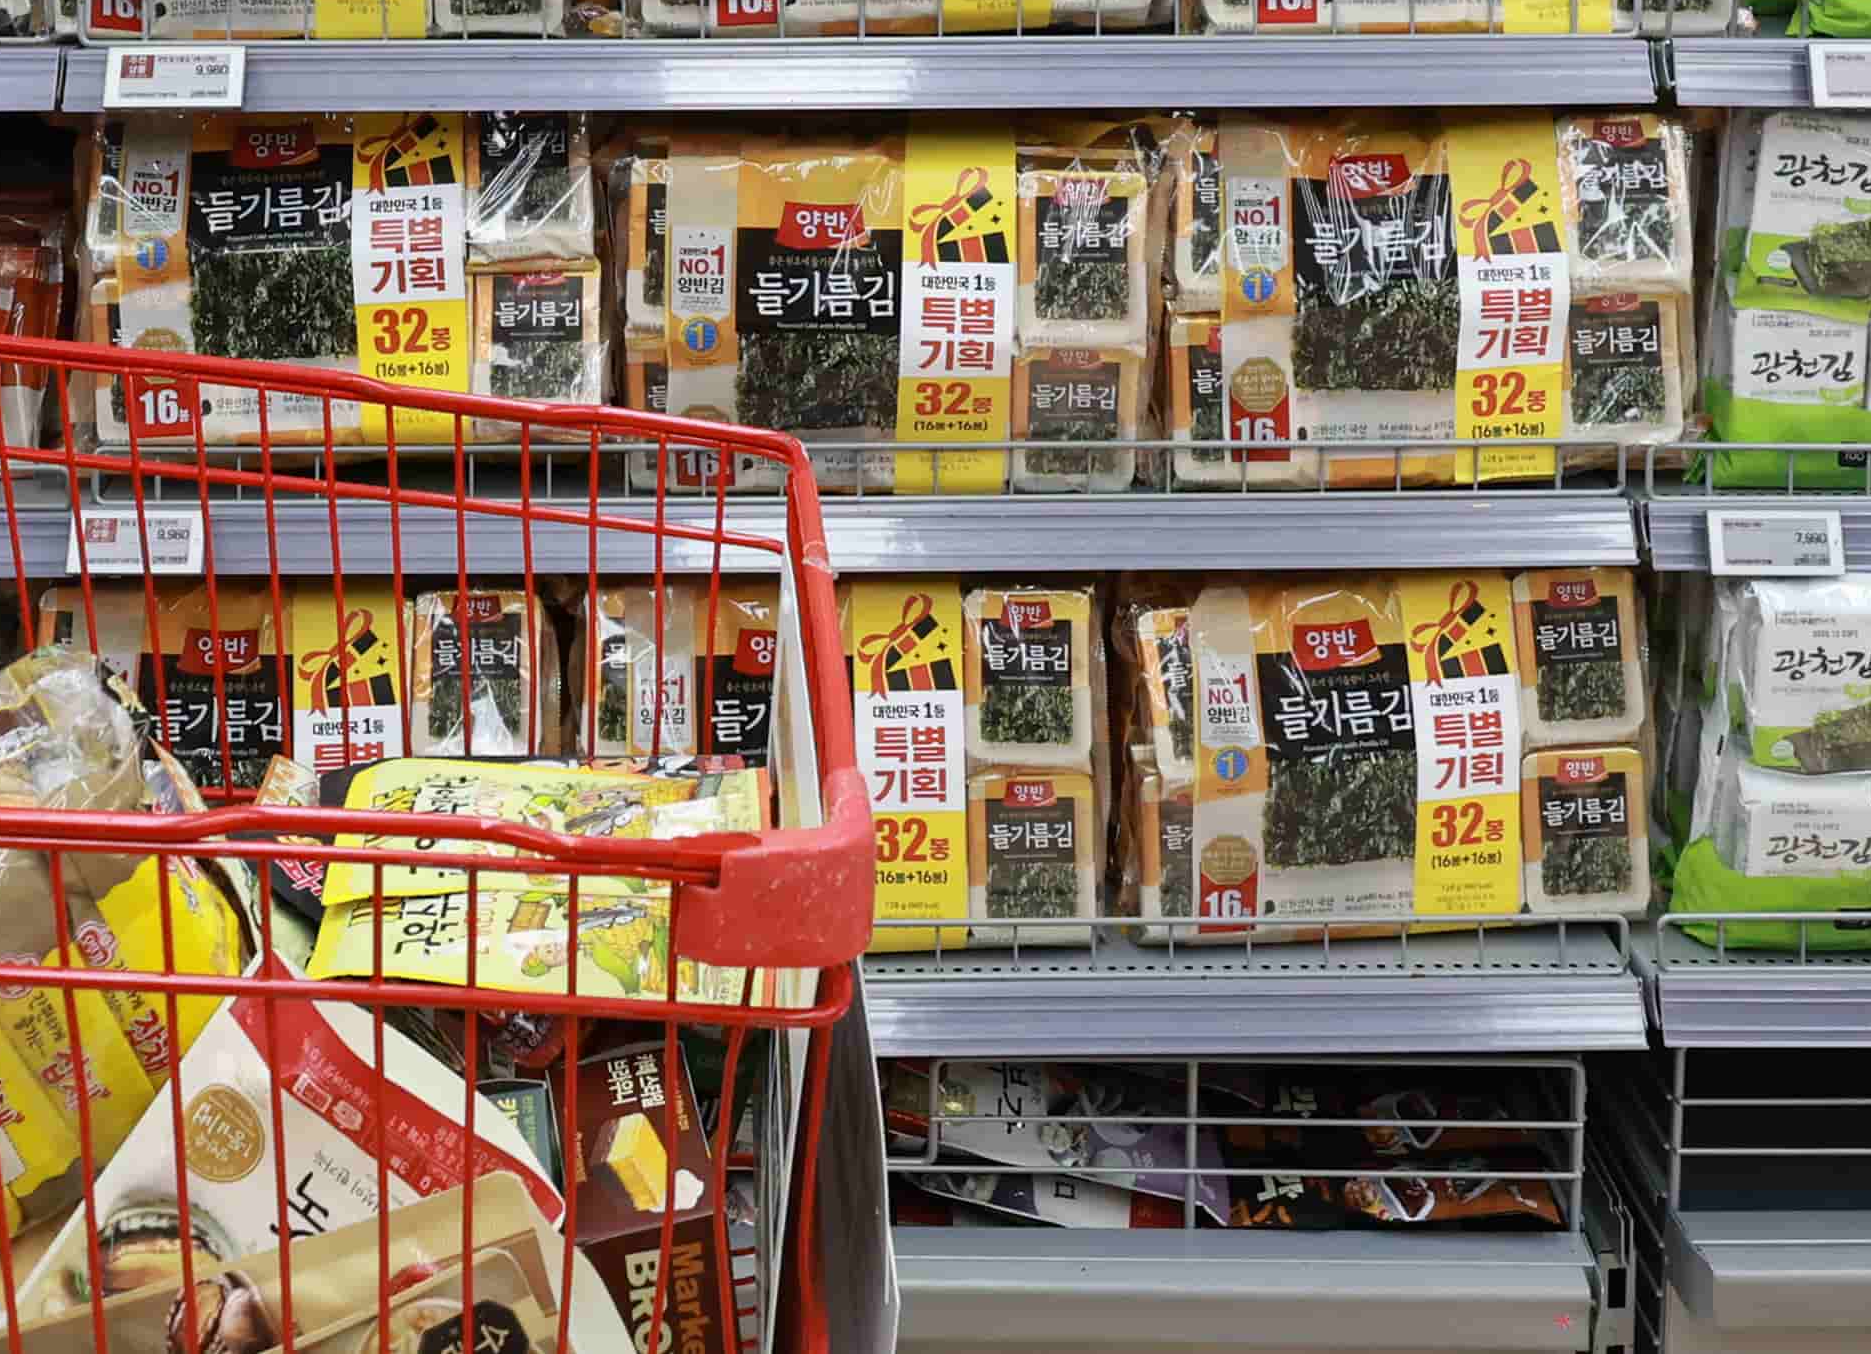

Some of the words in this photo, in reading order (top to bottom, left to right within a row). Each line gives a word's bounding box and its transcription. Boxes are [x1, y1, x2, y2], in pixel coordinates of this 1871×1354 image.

[132, 175, 179, 198] NO.1
[200, 186, 344, 232] 들기름김
[369, 198, 417, 213] 대한민국
[421, 195, 442, 212] 1등
[370, 216, 443, 255] 특별
[371, 259, 447, 294] 기획
[679, 277, 724, 295] 양반김
[1477, 267, 1526, 282] 대한민국
[1529, 265, 1551, 281] 1등
[921, 297, 995, 334] 특별
[1480, 288, 1552, 322] 특별
[920, 340, 994, 371] 기획
[1476, 328, 1548, 359] 기획
[1576, 327, 1659, 355] 들기름김
[1304, 628, 1356, 660] 양반
[873, 704, 920, 719] 대한민국
[923, 702, 945, 719] 1등
[1206, 705, 1251, 725] 양반김
[1430, 693, 1476, 710] 대한민국
[1479, 690, 1501, 707] 1등
[874, 725, 947, 761] 특별
[1432, 710, 1503, 750] 특별
[874, 766, 948, 803] 기획
[1434, 753, 1505, 793] 기획
[988, 820, 1073, 851] 들기름김
[673, 1243, 709, 1353] Marke
